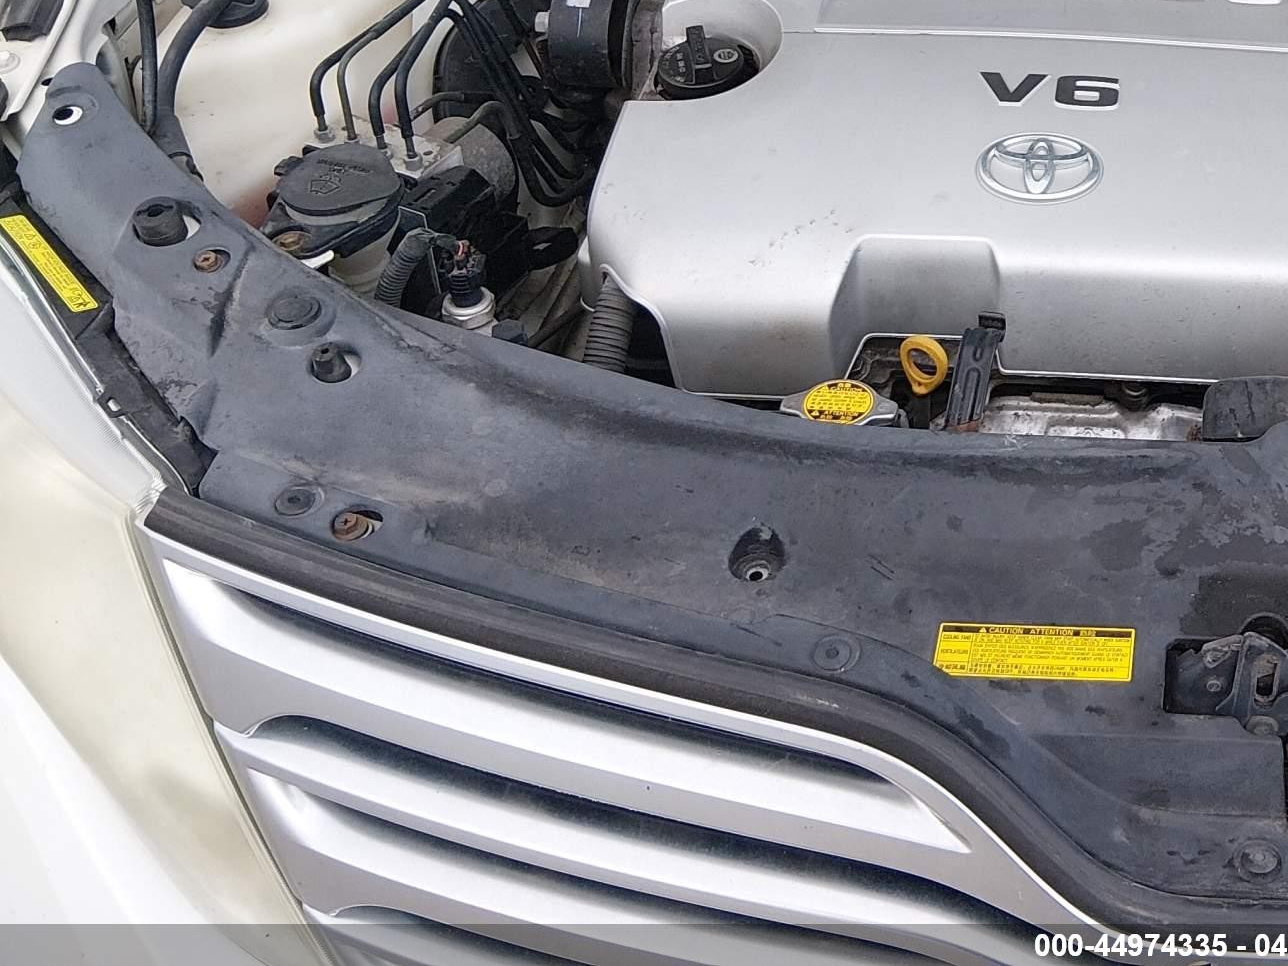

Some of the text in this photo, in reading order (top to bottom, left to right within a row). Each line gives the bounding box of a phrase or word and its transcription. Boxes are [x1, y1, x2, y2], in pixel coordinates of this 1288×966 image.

[979, 71, 1120, 109] V6
[989, 627, 1024, 635] CAUTION
[1030, 628, 1074, 636] ATTENTION
